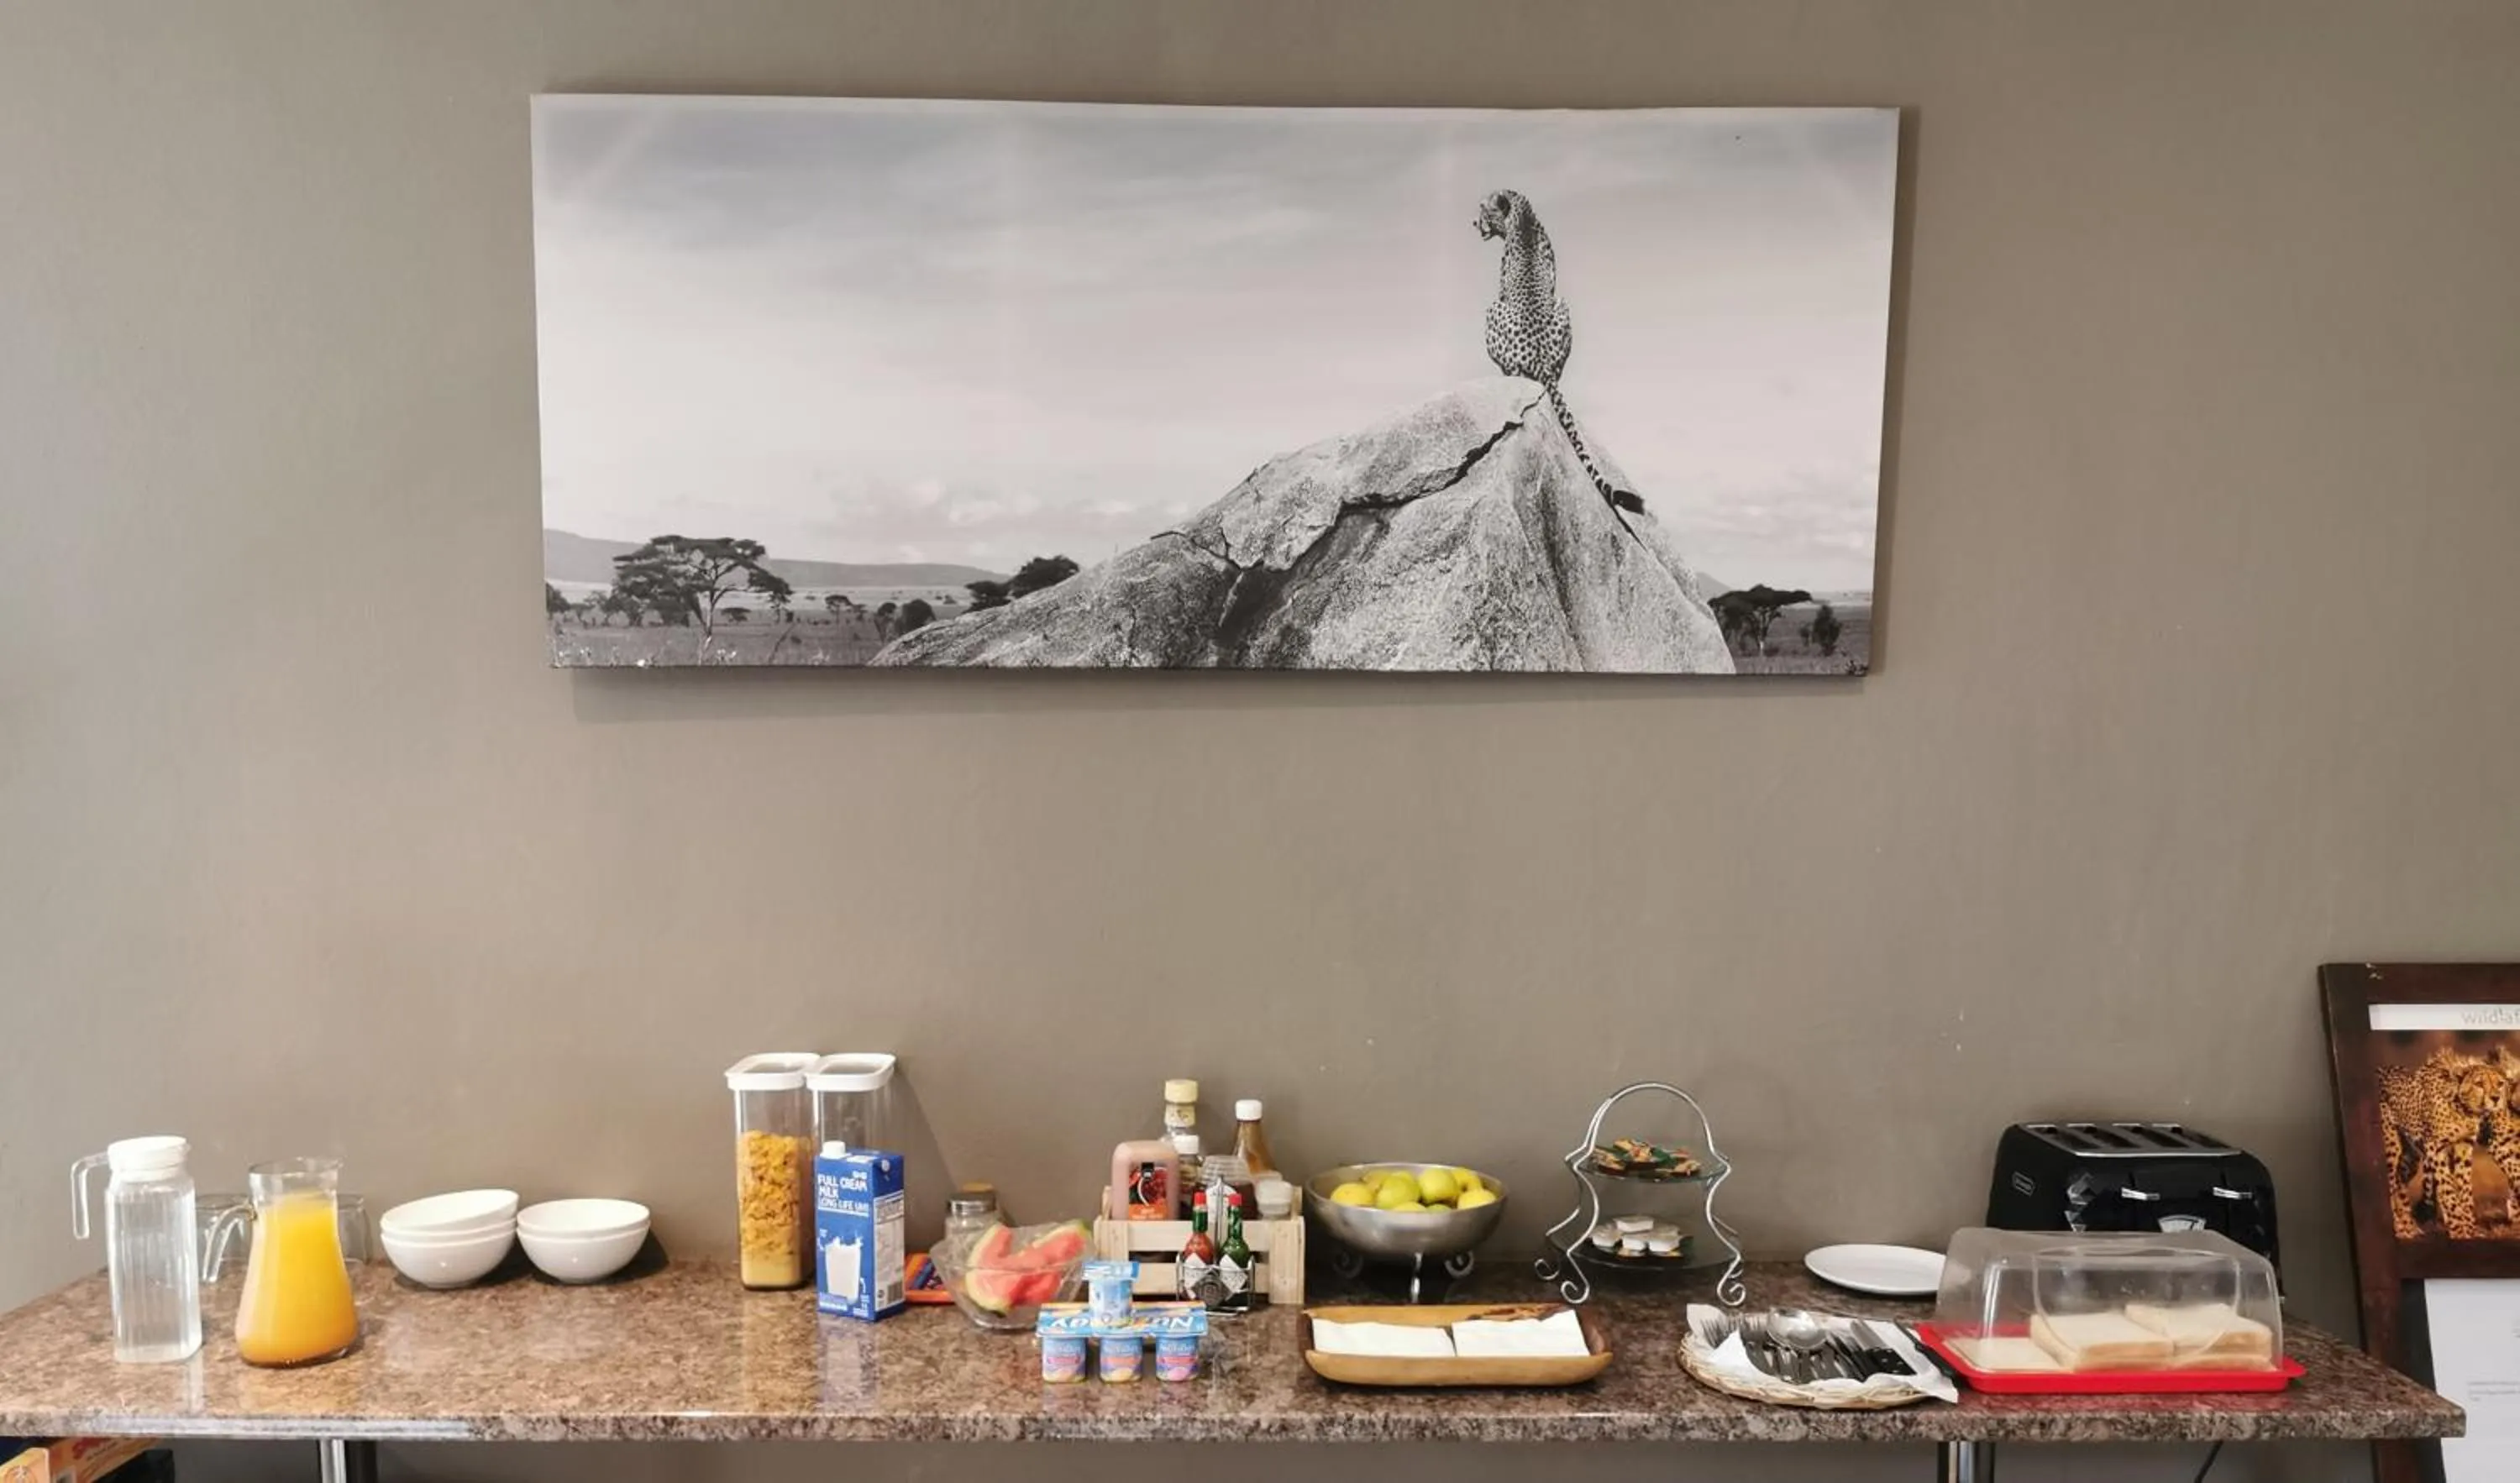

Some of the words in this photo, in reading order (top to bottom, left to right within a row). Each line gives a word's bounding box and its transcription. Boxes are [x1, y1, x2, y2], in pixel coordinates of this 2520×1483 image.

[817, 1173, 838, 1186] FULL
[840, 1176, 869, 1192] CREAM
[818, 1185, 839, 1198] MILK
